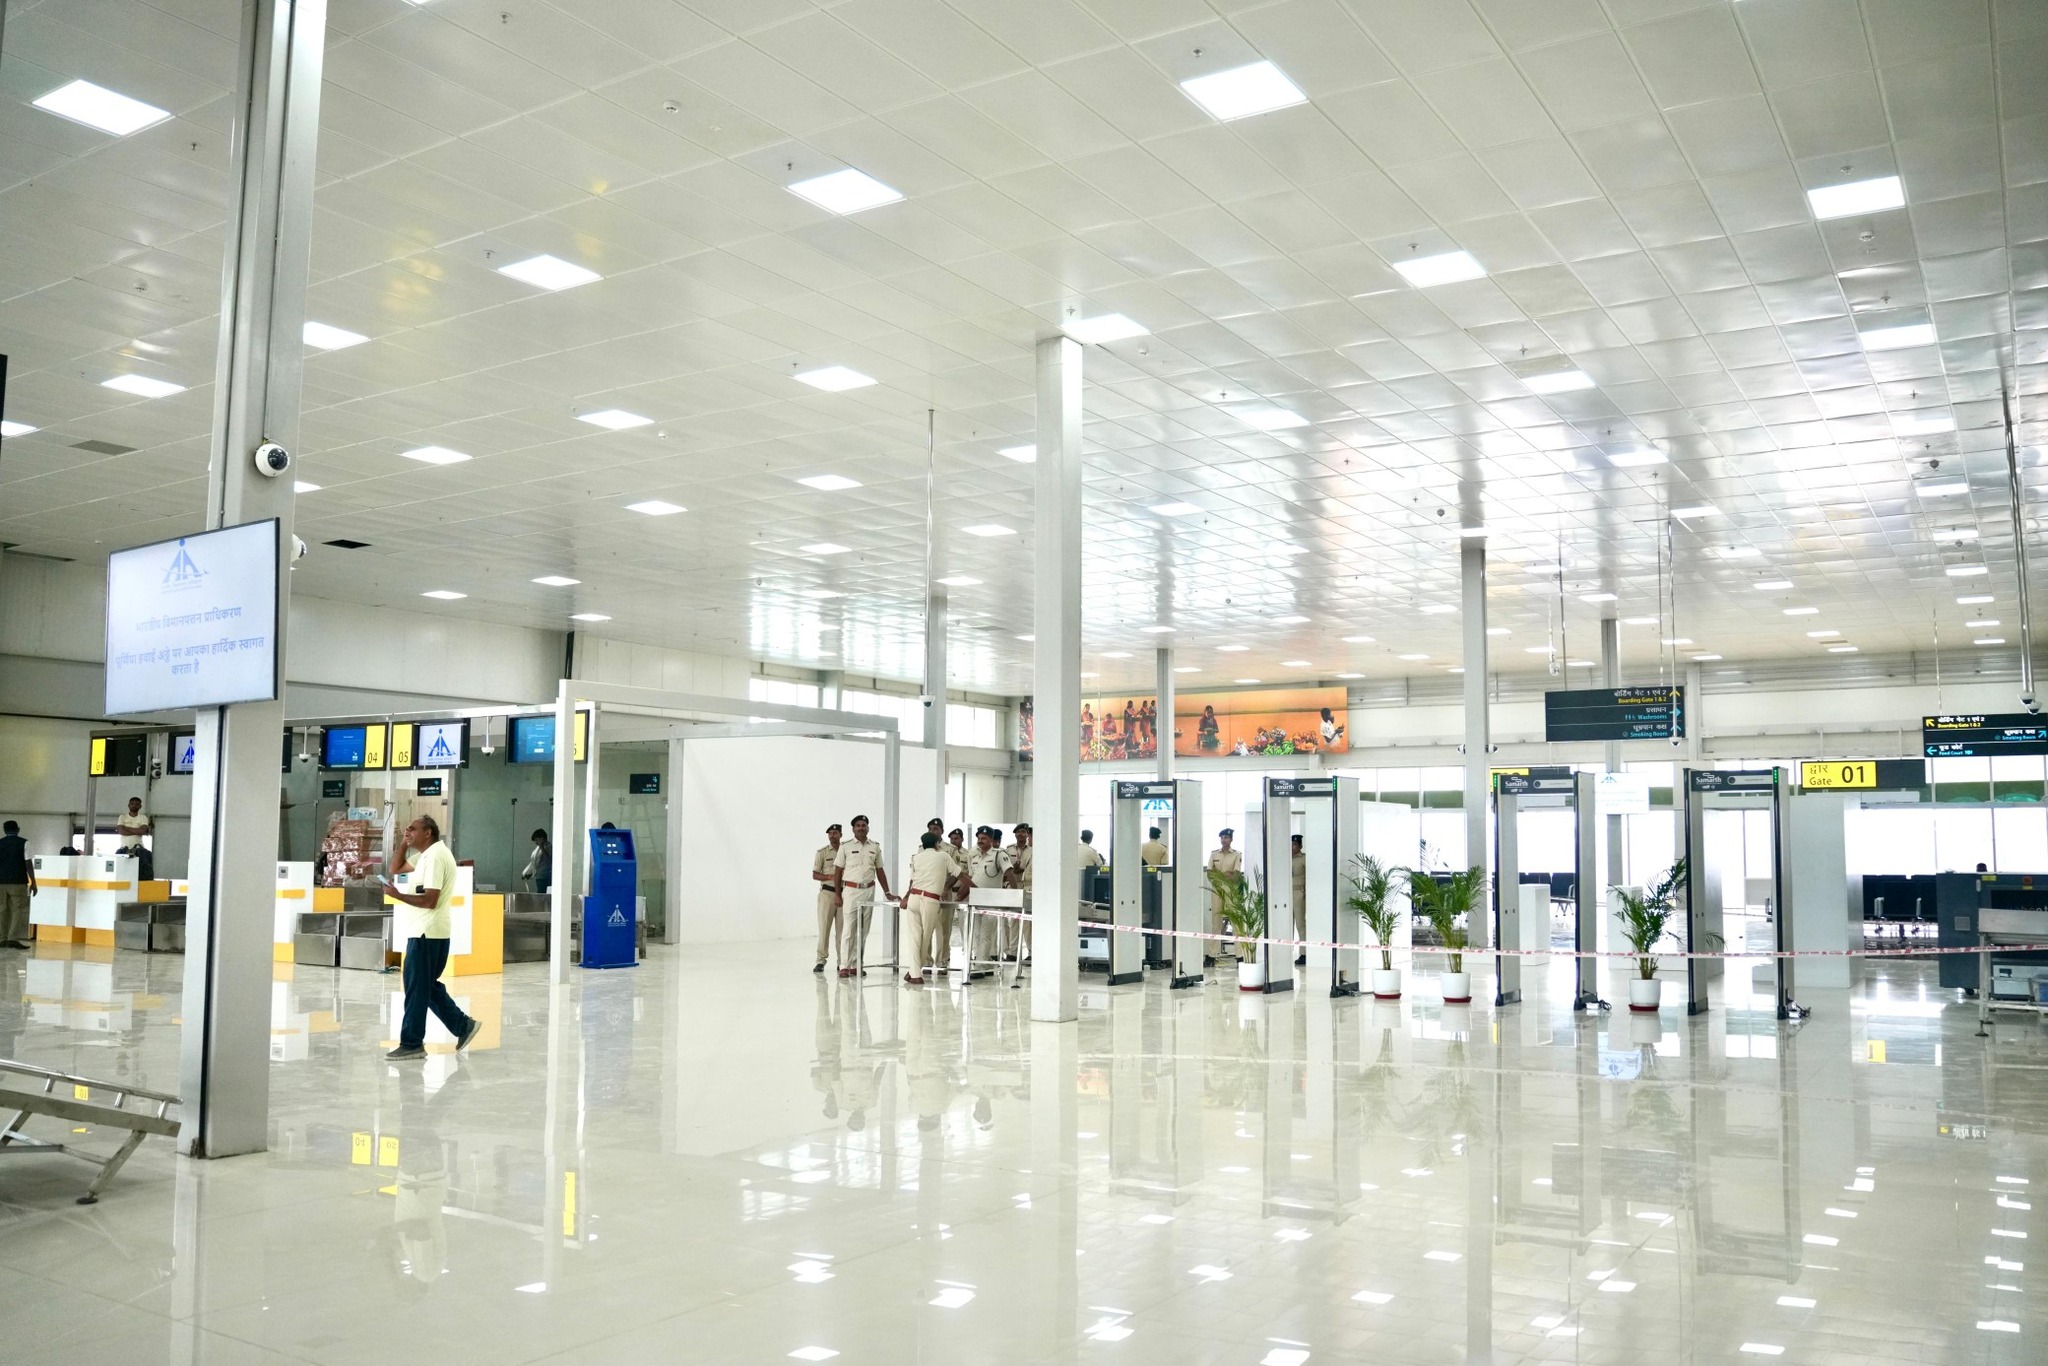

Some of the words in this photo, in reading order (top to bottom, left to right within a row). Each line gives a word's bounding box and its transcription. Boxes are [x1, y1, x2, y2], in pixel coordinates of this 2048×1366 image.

[204, 606, 242, 622] प्राधिकरण
[172, 648, 182, 658] पर
[184, 644, 210, 656] आपका
[212, 637, 236, 654] हार्दिक
[238, 636, 264, 650] स्वागत
[171, 663, 192, 675] करता
[193, 658, 200, 674] है
[368, 752, 378, 764] 04
[398, 751, 408, 763] 05
[1810, 777, 1832, 786] Gate
[1842, 766, 1864, 784] 01
